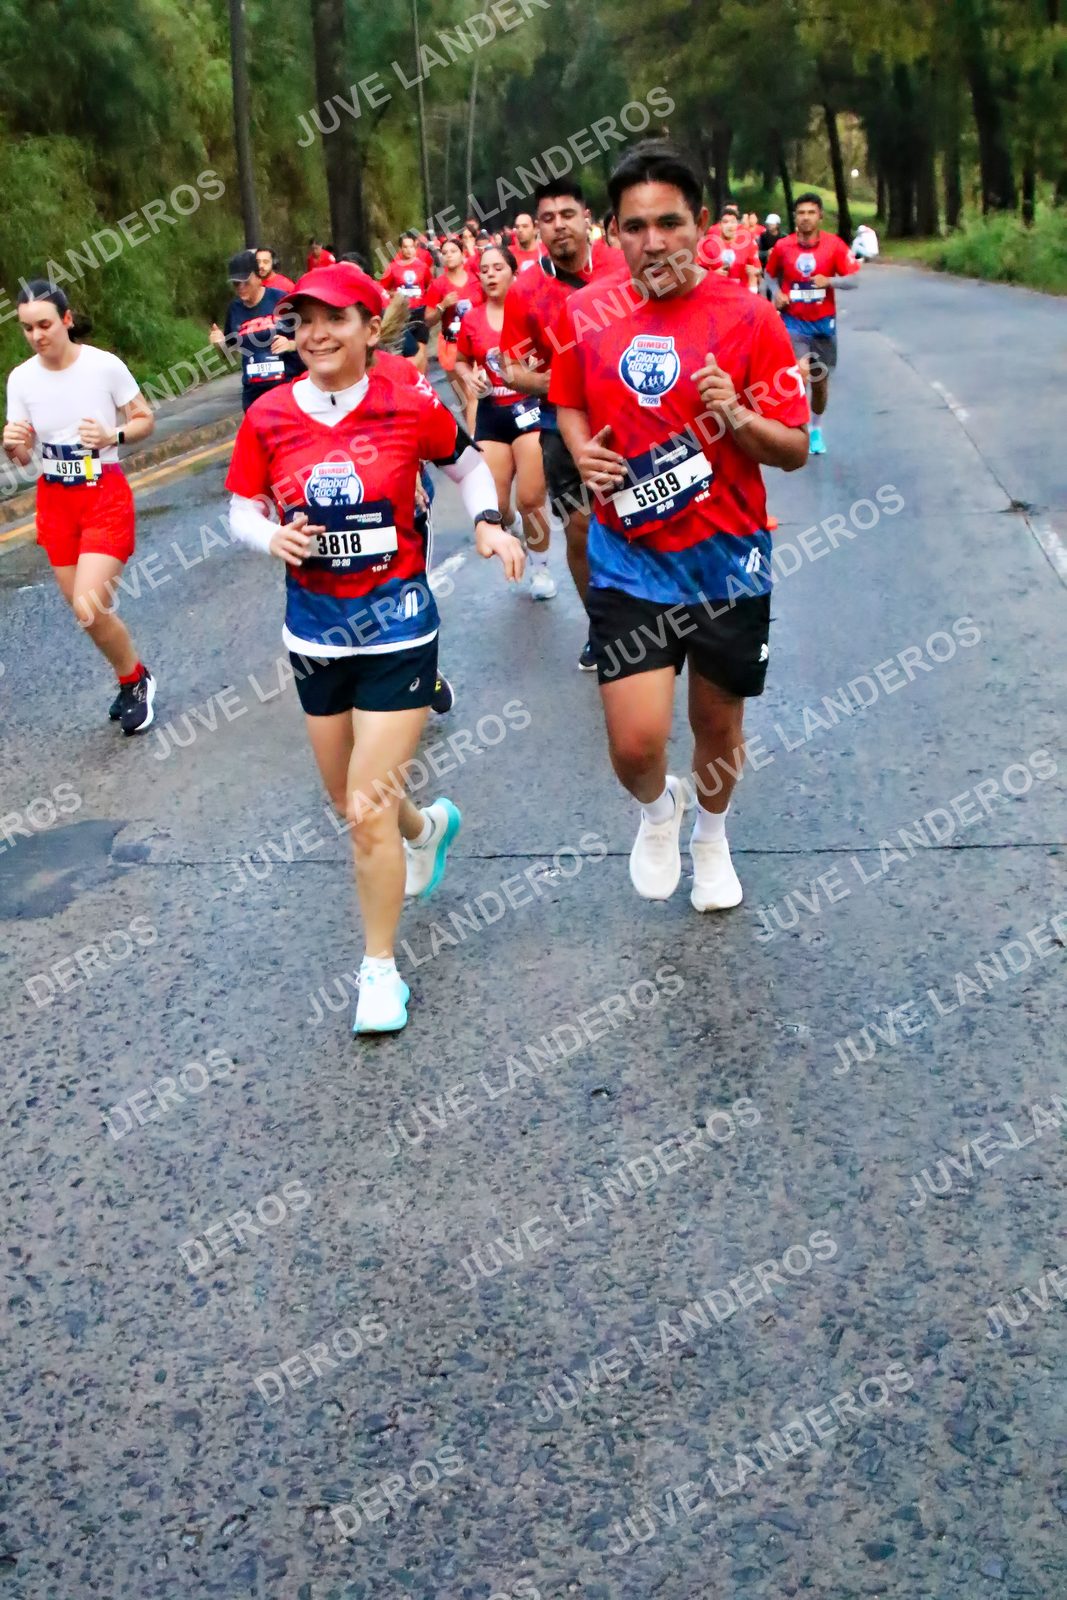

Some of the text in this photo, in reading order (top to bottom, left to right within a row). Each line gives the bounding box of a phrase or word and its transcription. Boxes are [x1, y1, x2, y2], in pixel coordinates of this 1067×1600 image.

[637, 341, 668, 349] BIMBO
[635, 352, 666, 364] Global
[629, 361, 654, 372] Race
[641, 397, 659, 405] 2026
[56, 461, 81, 474] 4976
[318, 477, 349, 489] Global
[313, 487, 338, 497] Race
[632, 471, 681, 508] 5589
[317, 532, 362, 555] 3818
